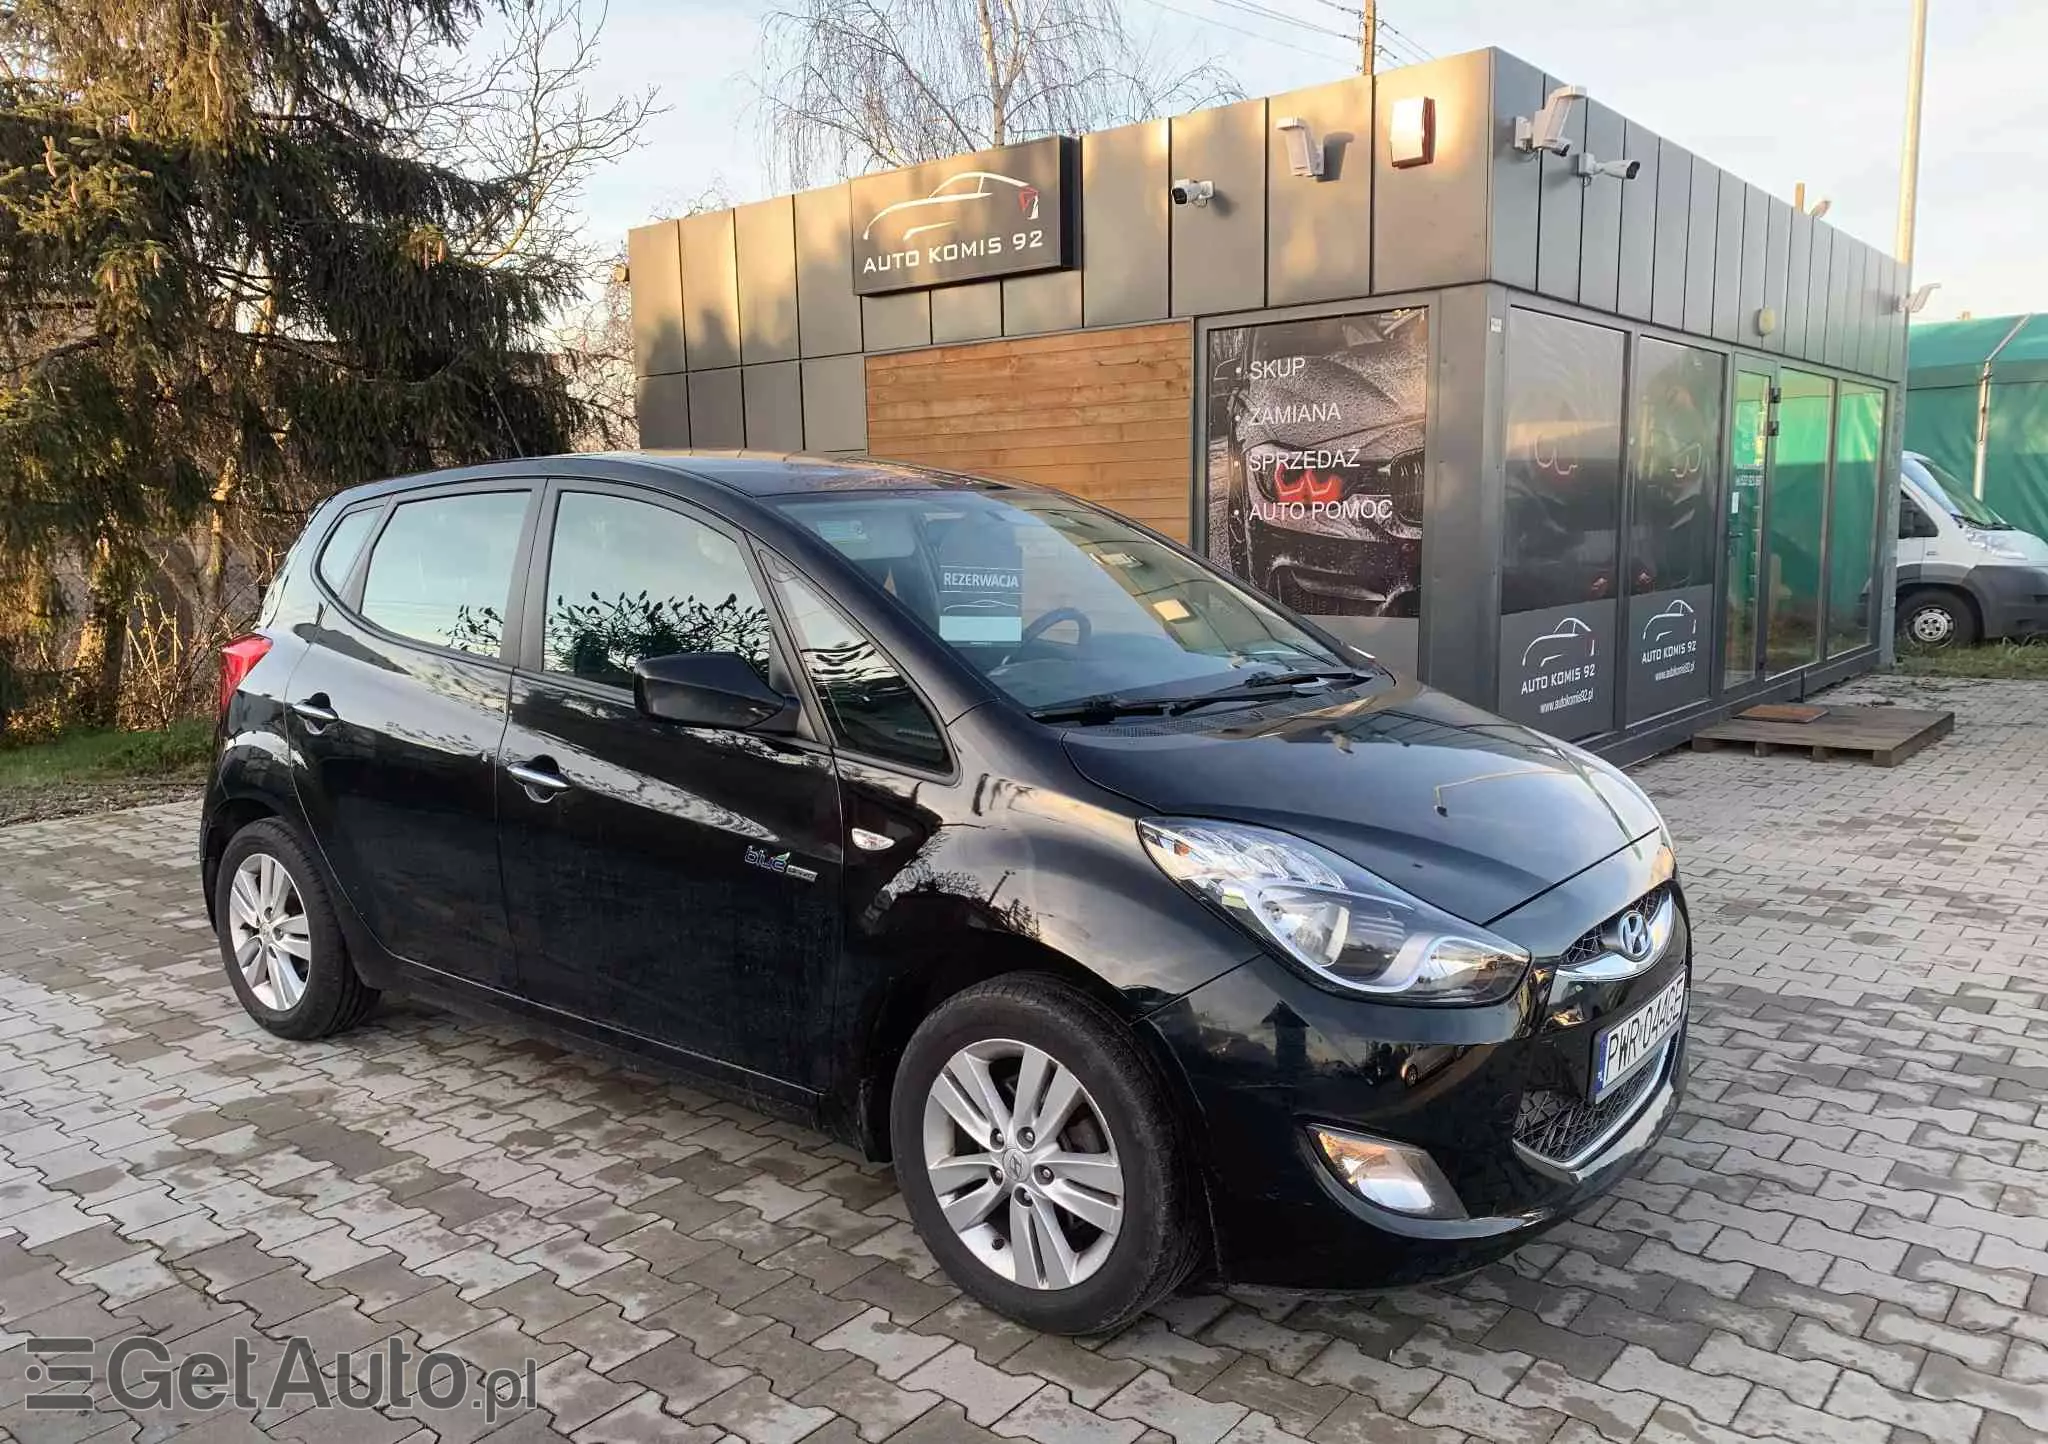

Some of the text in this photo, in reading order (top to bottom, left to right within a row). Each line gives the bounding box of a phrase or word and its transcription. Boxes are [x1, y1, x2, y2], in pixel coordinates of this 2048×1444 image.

[863, 230, 1044, 274] AUTO KOMIS 92
[1249, 357, 1306, 380] SKUP
[1249, 402, 1342, 426] ZAMIANA
[1249, 500, 1394, 521] AUTO POMOC
[943, 572, 1020, 588] REZERWACJA
[1642, 640, 1697, 664] AUTO KOMIS 92
[1521, 663, 1596, 695] AUTO KOMIS 92
[1540, 688, 1594, 714] www.autokomis92.pl
[1605, 1018, 1640, 1081] PWR
